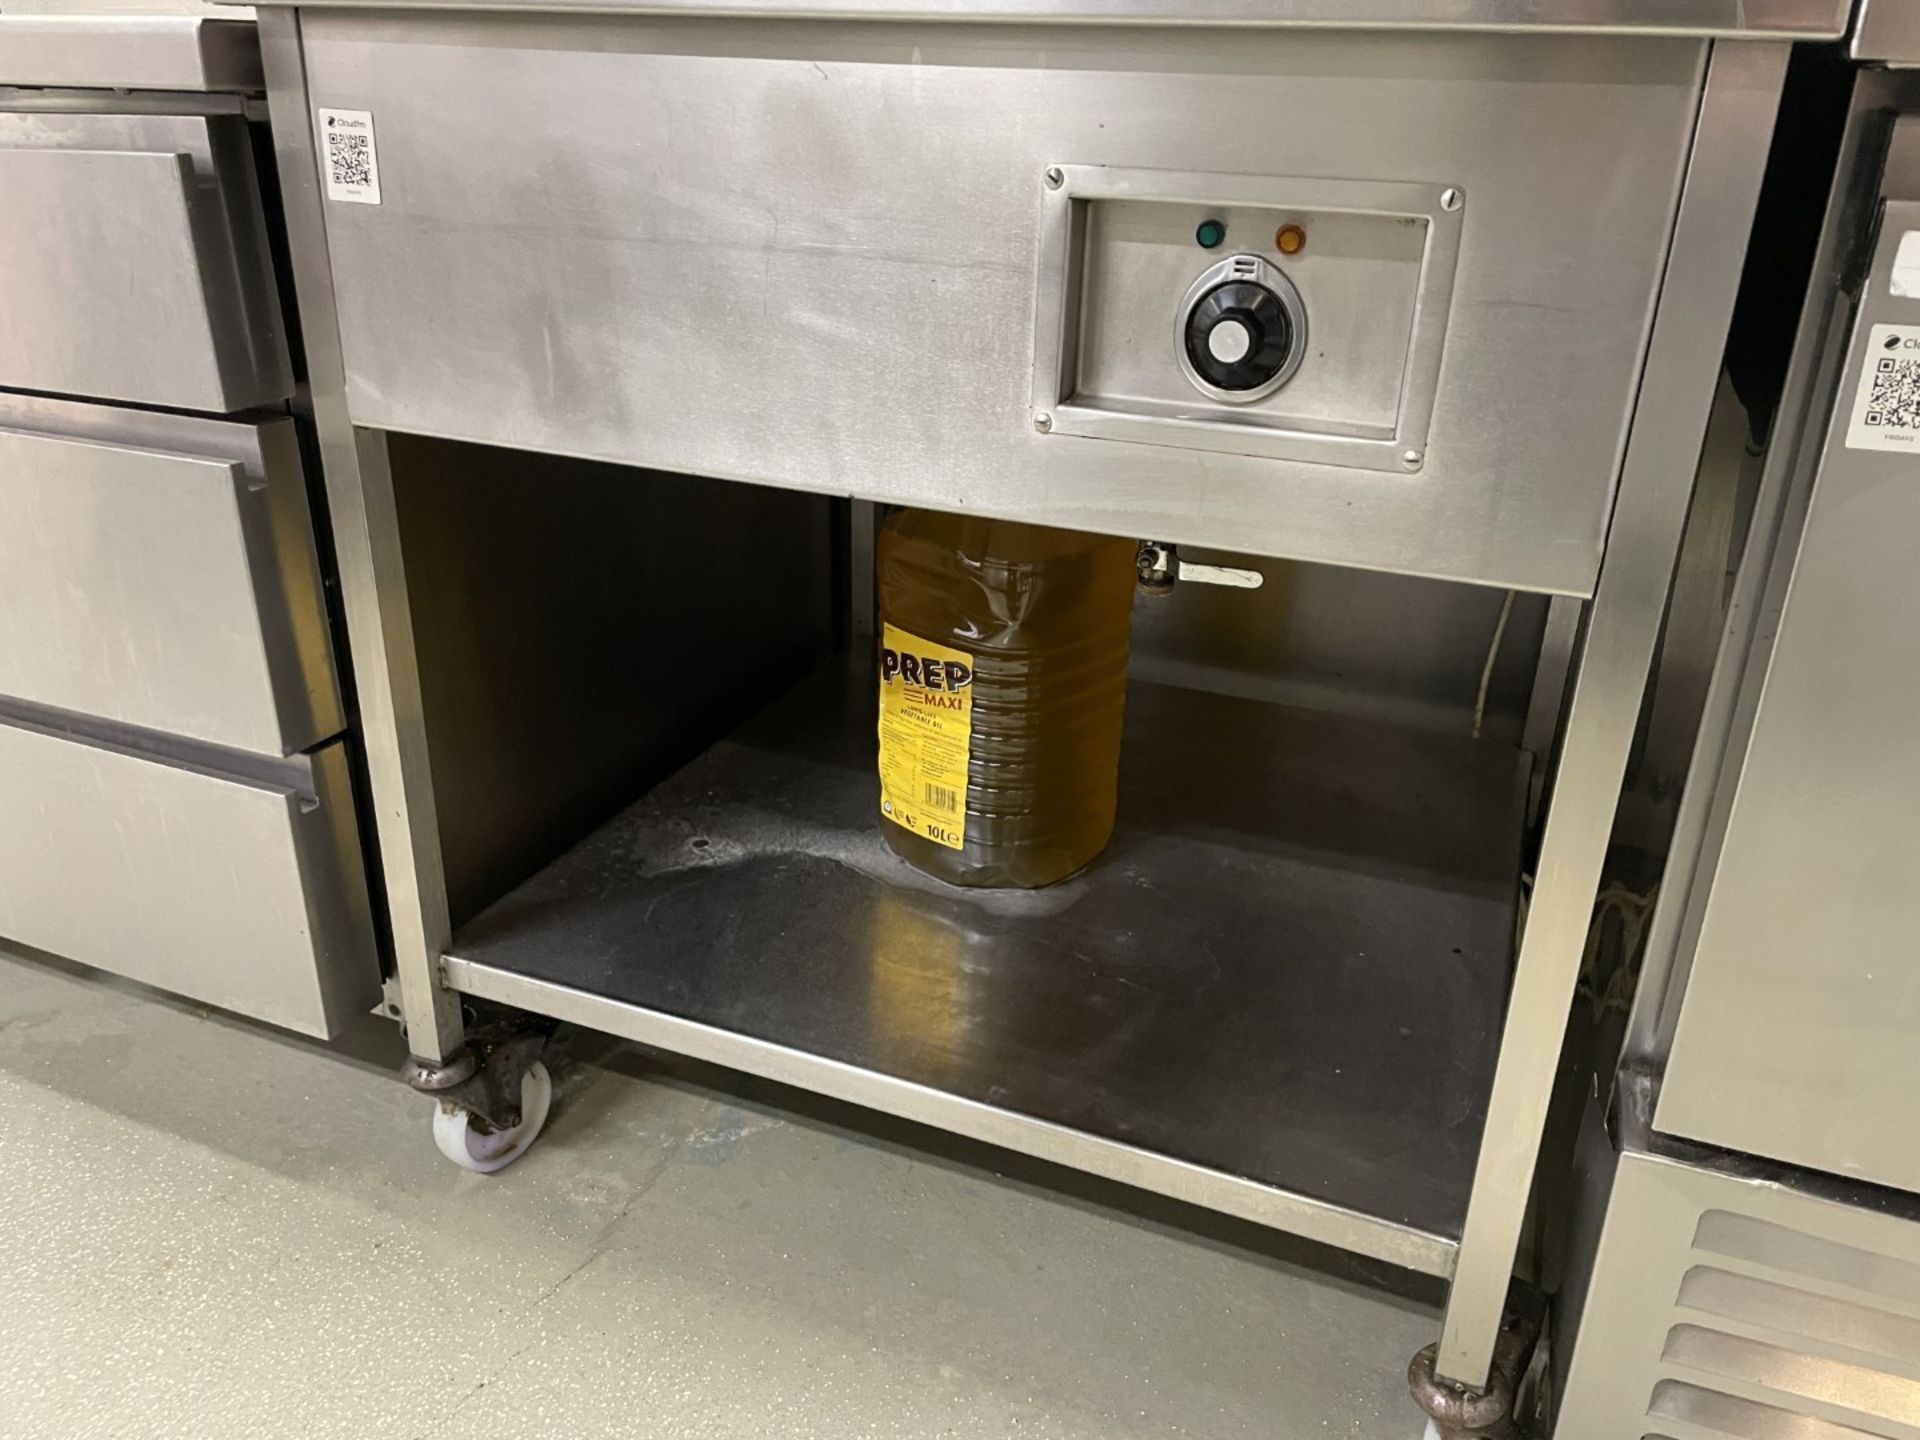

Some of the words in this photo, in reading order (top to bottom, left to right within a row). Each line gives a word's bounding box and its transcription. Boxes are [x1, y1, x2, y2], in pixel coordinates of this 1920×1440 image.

[881, 648, 972, 694] PREP
[924, 694, 962, 710] MAXI
[900, 708, 931, 725] VEGETABLE
